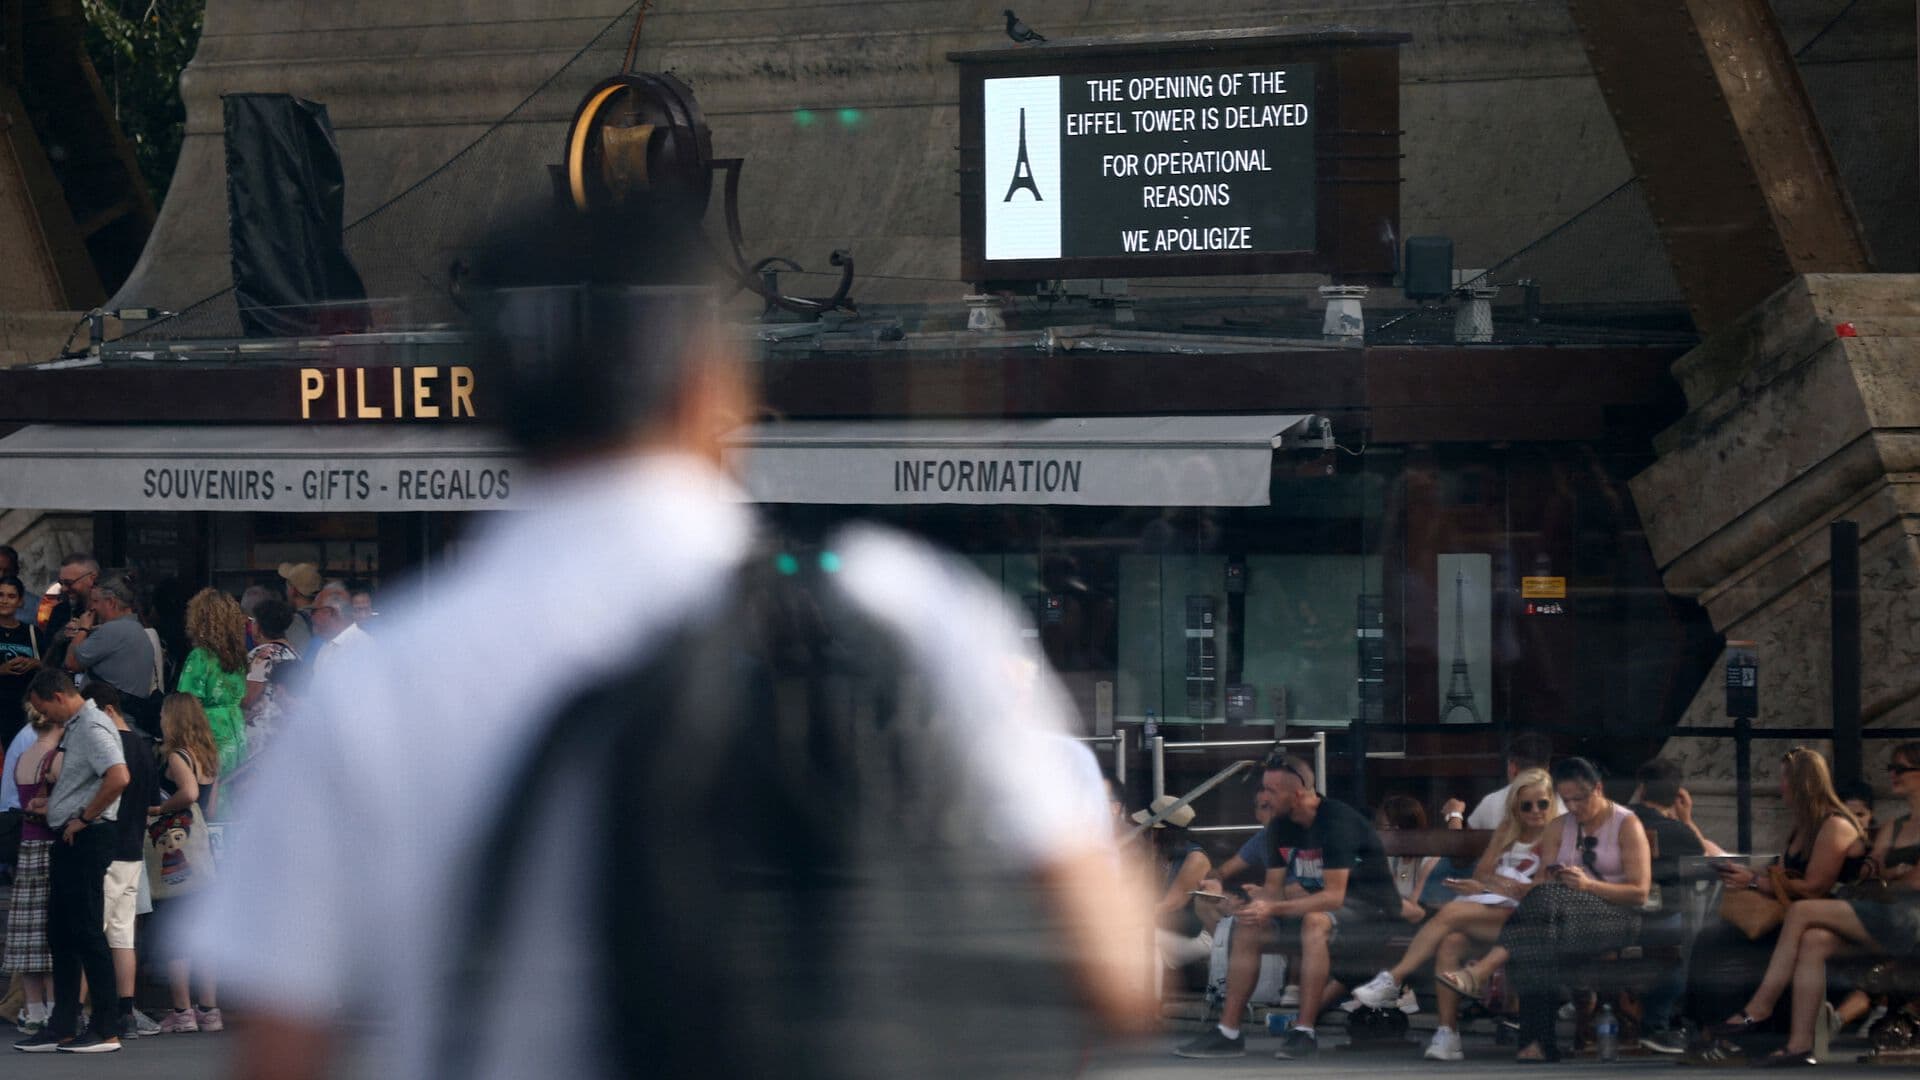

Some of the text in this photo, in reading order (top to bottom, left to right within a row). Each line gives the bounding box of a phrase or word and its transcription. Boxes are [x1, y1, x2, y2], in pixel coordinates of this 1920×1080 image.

[1086, 71, 1287, 102] THE OPENING OF THE
[1066, 103, 1308, 136] EIFFEL TOWER IS DELAYED
[1103, 149, 1272, 178] FOR OPERATIONAL
[1143, 183, 1230, 208] REASONS
[1121, 226, 1253, 252] WE APOLIGIZE
[300, 366, 475, 419] PILIER
[143, 468, 275, 501] SOUVENIRS
[302, 470, 370, 500] GIFTS
[398, 468, 511, 500] REGALOS
[894, 459, 1082, 493] INFORMATION
